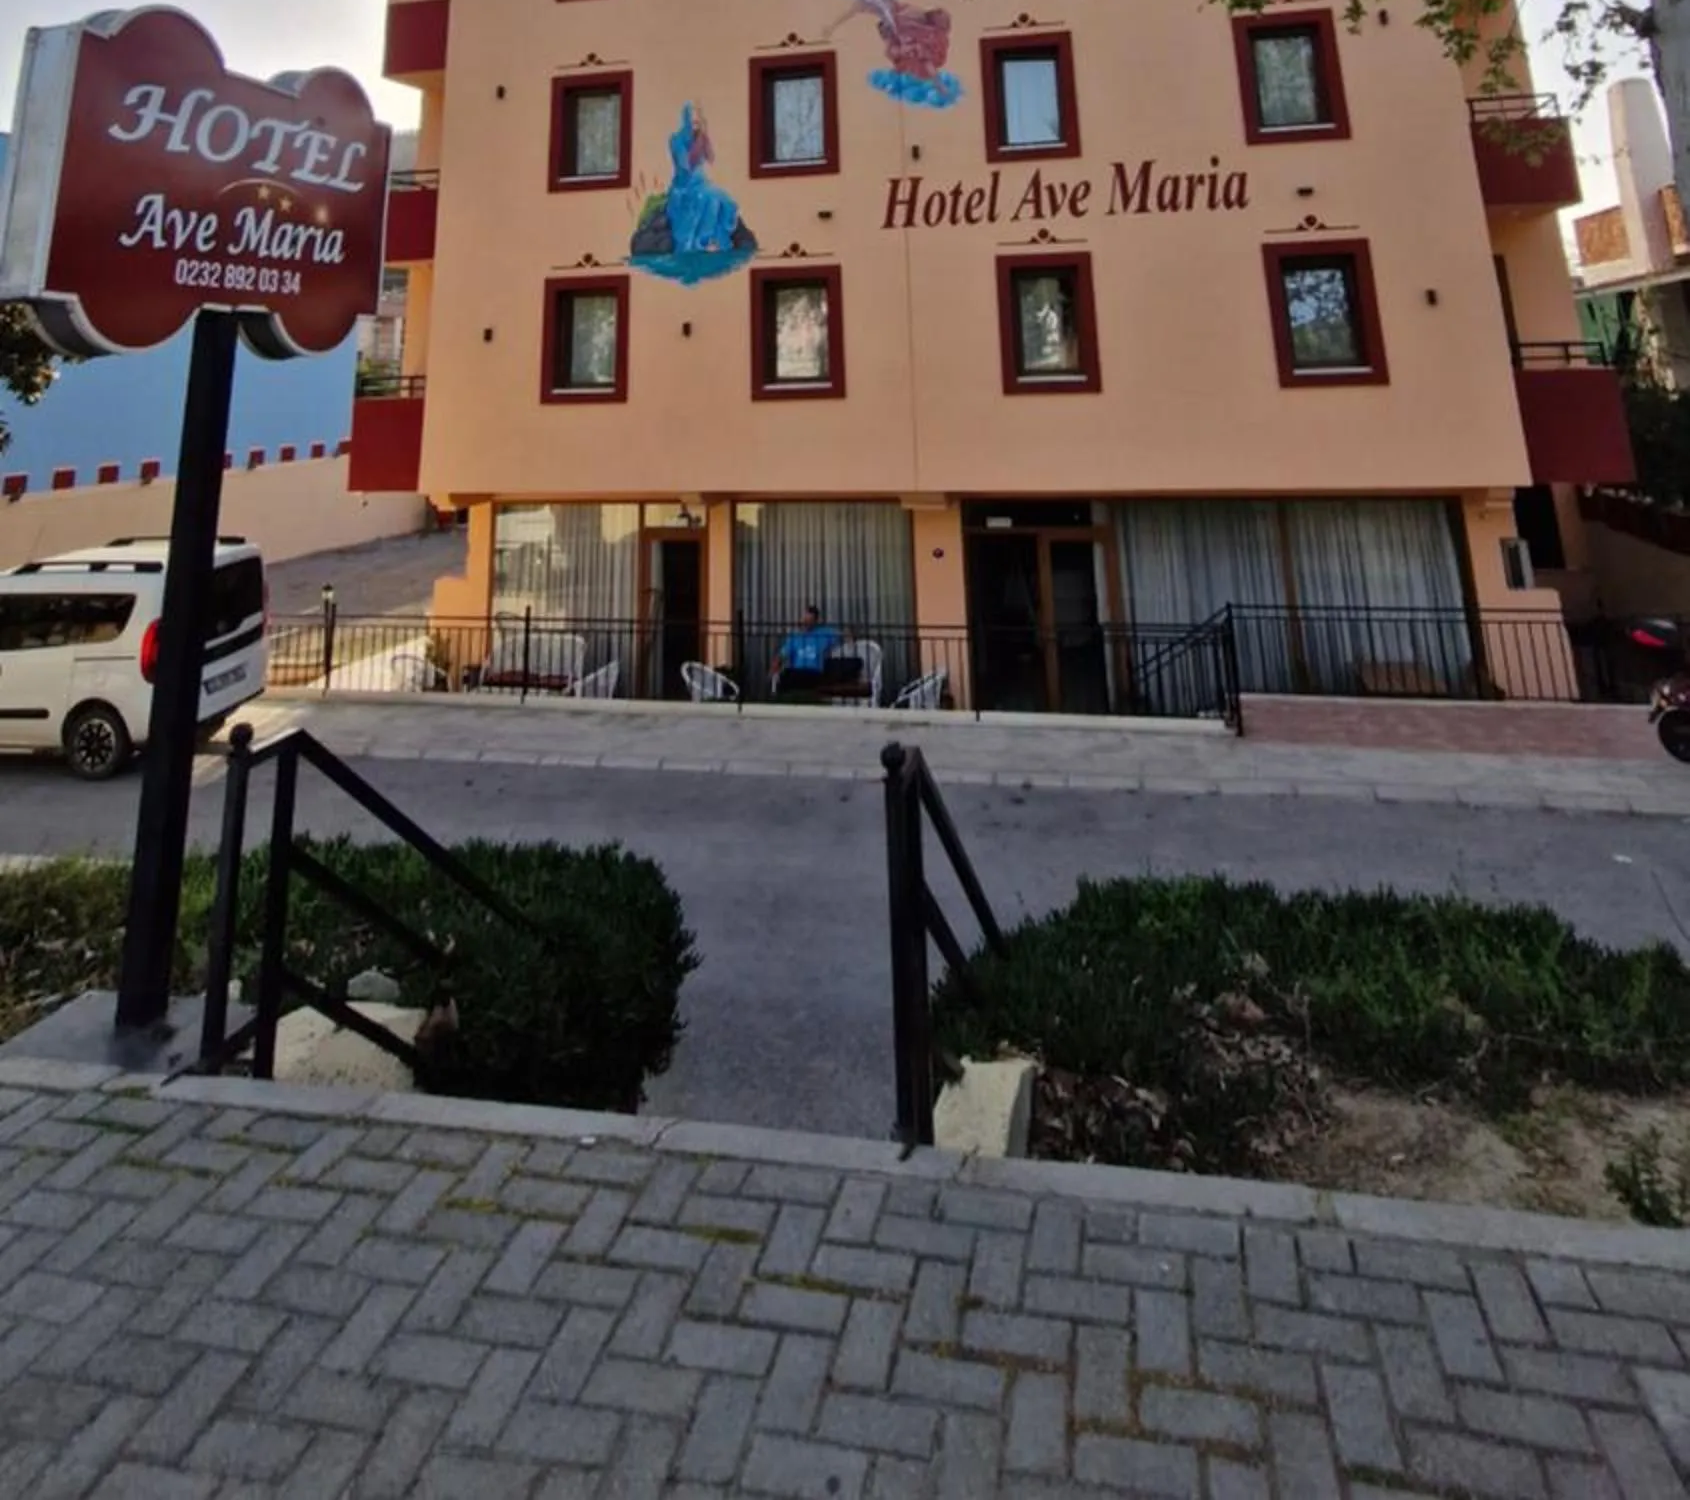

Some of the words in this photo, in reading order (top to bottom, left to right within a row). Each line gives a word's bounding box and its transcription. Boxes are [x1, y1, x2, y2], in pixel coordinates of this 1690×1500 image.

[108, 84, 367, 192] HOTEL
[119, 193, 218, 252] Ave
[880, 170, 1000, 229] Hotel
[1011, 168, 1092, 221] Ave
[1105, 155, 1250, 215] Maria
[175, 258, 221, 288] 0232
[224, 263, 255, 291] 892
[258, 269, 278, 293] 03
[281, 272, 301, 295] 34
